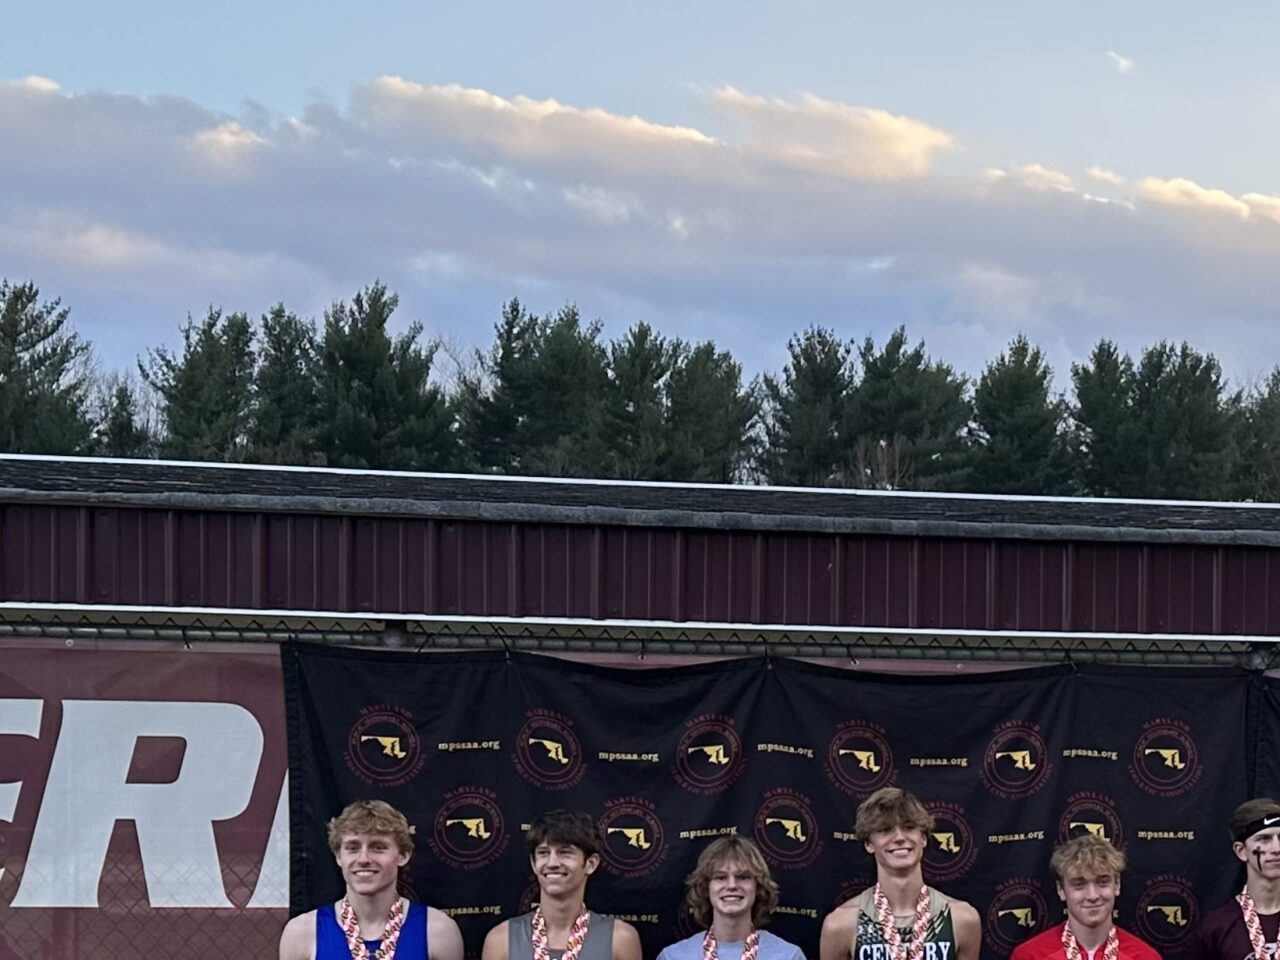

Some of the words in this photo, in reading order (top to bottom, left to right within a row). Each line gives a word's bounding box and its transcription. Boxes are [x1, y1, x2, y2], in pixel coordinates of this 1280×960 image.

[438, 739, 501, 751] mpssaa.org
[758, 744, 813, 757] mpssaa.org
[599, 753, 659, 762] mpssaa.org
[1062, 748, 1118, 760] mpssaa.org
[910, 756, 968, 767] mpssaa.org
[680, 827, 738, 840] mpssaa.org
[989, 831, 1044, 843] mpssaa.org
[1136, 830, 1194, 841] mpssaa.org
